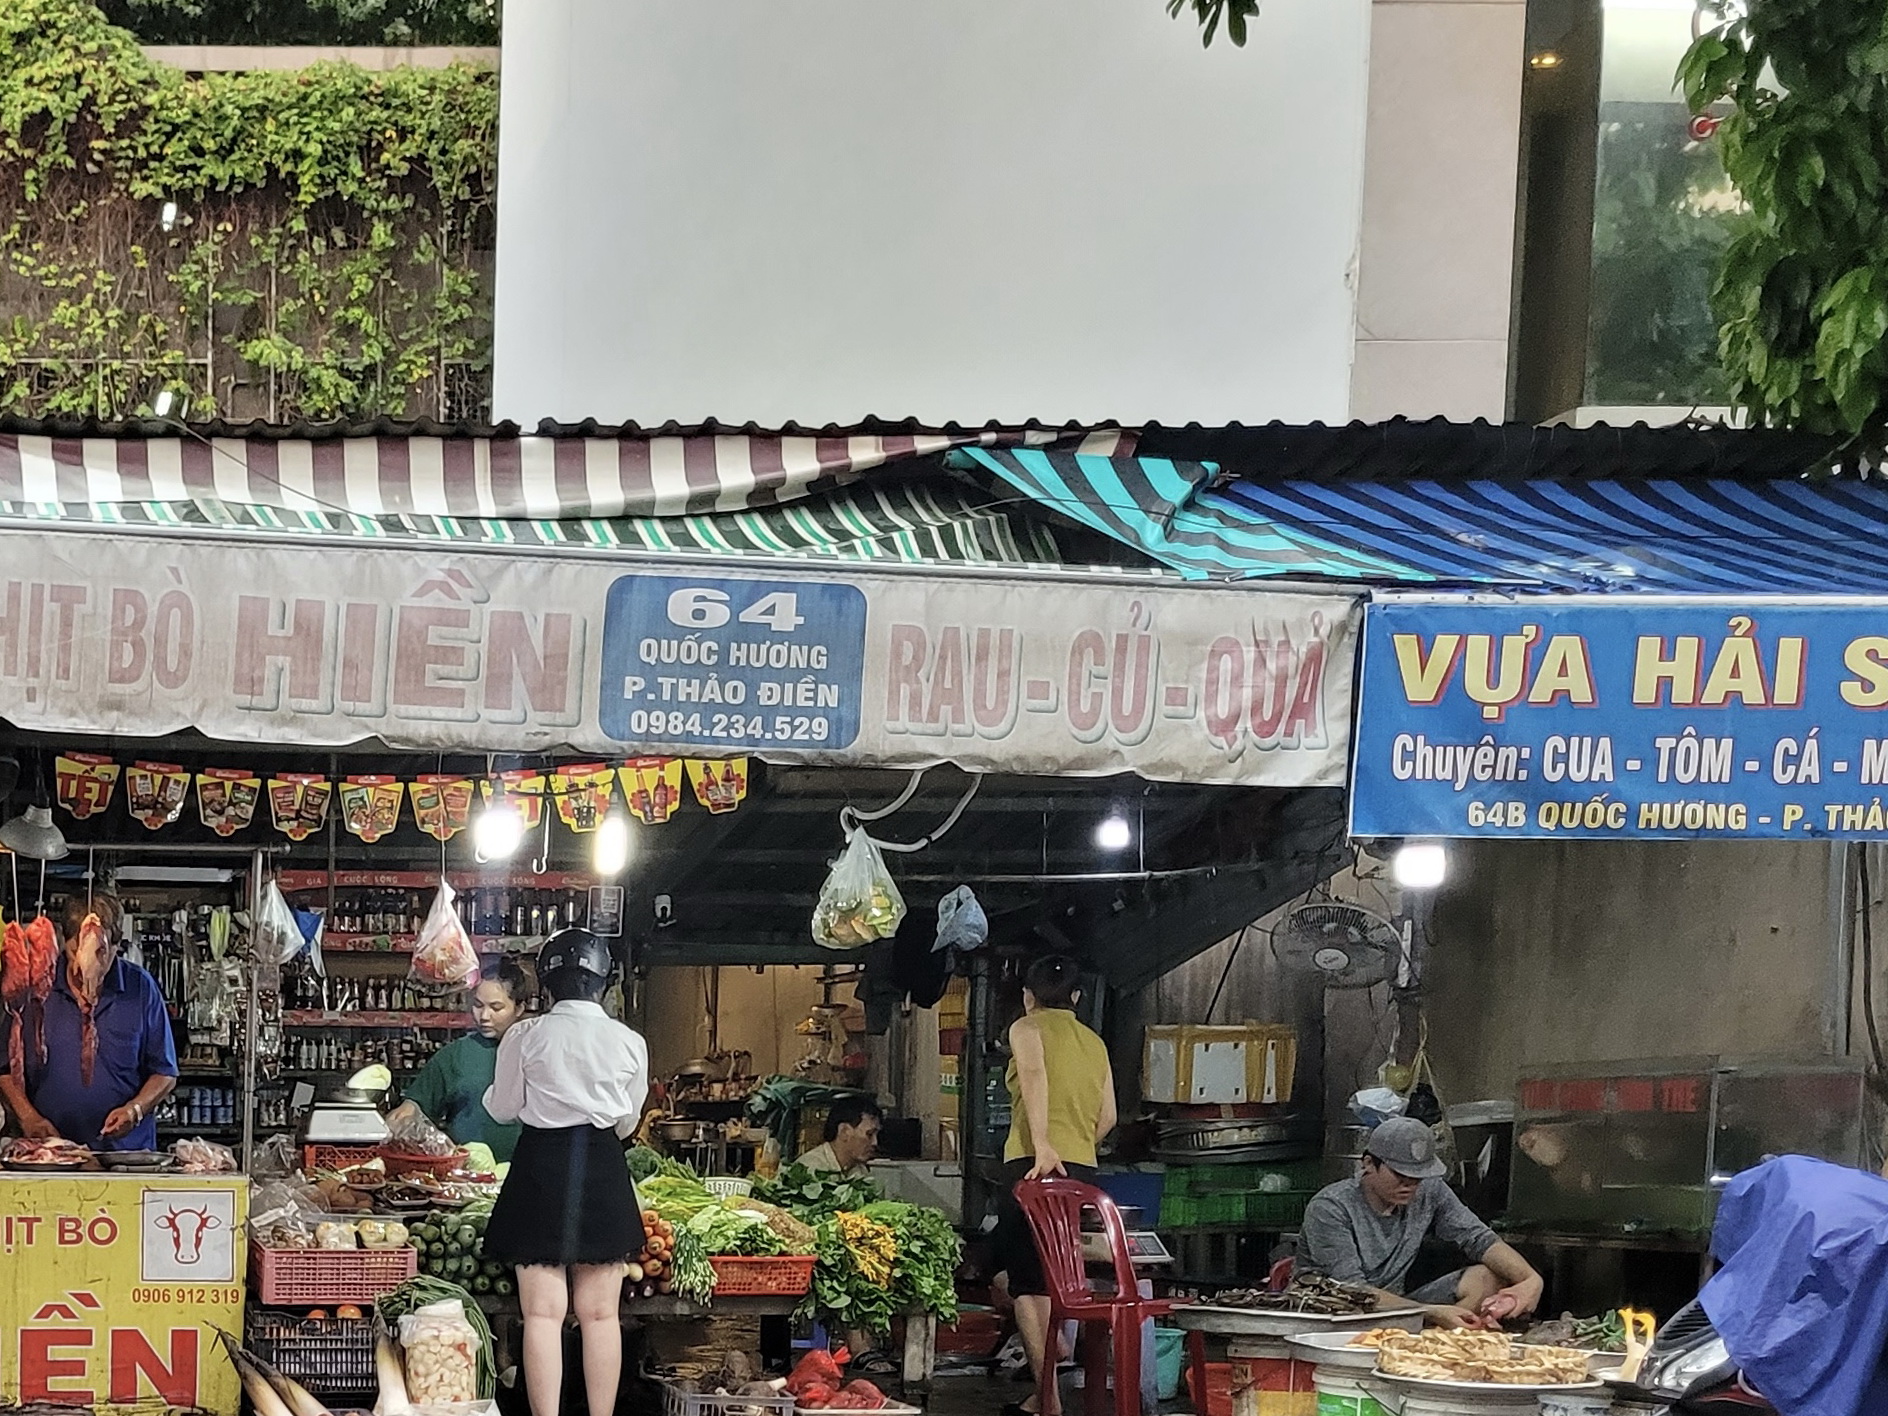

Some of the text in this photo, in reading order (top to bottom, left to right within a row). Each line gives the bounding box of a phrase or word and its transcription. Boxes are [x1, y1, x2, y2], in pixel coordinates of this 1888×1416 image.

[667, 588, 805, 632] 64
[107, 566, 195, 690] BÒ
[232, 567, 574, 714] HIỀN
[639, 632, 828, 669] QUỐC HƯƠNG
[1393, 624, 1592, 722] VỰA
[1632, 616, 1804, 708] HẢI
[623, 672, 840, 708] P.THẢO ĐIỀN
[630, 710, 829, 741] 0984.234.529
[1392, 734, 1531, 791] Chuyên:
[1542, 735, 1614, 784] CUA
[1655, 727, 1732, 784] TÔM
[1772, 727, 1821, 785] CÁ
[1468, 802, 1526, 828] 64B
[1538, 793, 1627, 831] QUỐC
[1638, 799, 1747, 830] HƯƠNG
[1782, 804, 1812, 831] P.
[57, 1208, 119, 1247] BÒ
[132, 1288, 240, 1304] 0906 912 319
